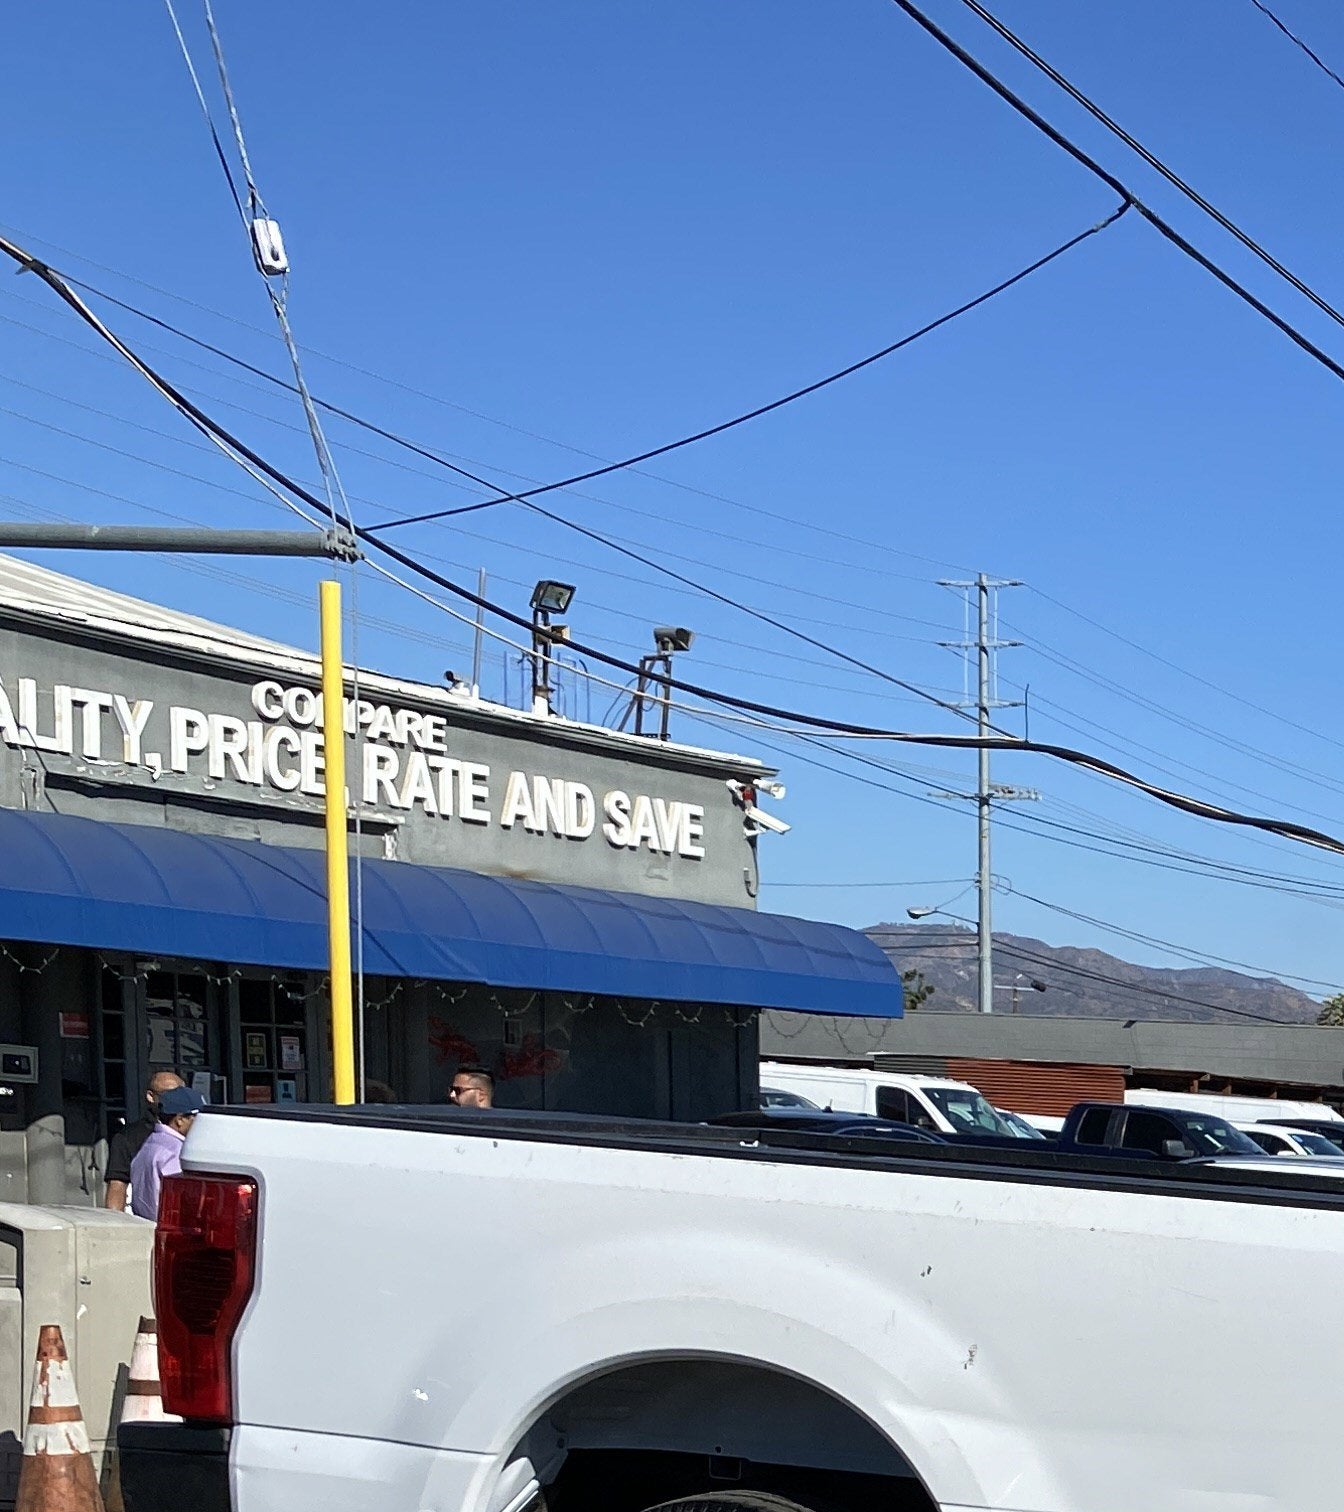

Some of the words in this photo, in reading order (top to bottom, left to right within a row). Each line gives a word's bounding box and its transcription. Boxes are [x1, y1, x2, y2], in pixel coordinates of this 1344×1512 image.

[363, 743, 491, 822] RATE
[501, 771, 596, 838] AND
[603, 790, 706, 858] SAVE
